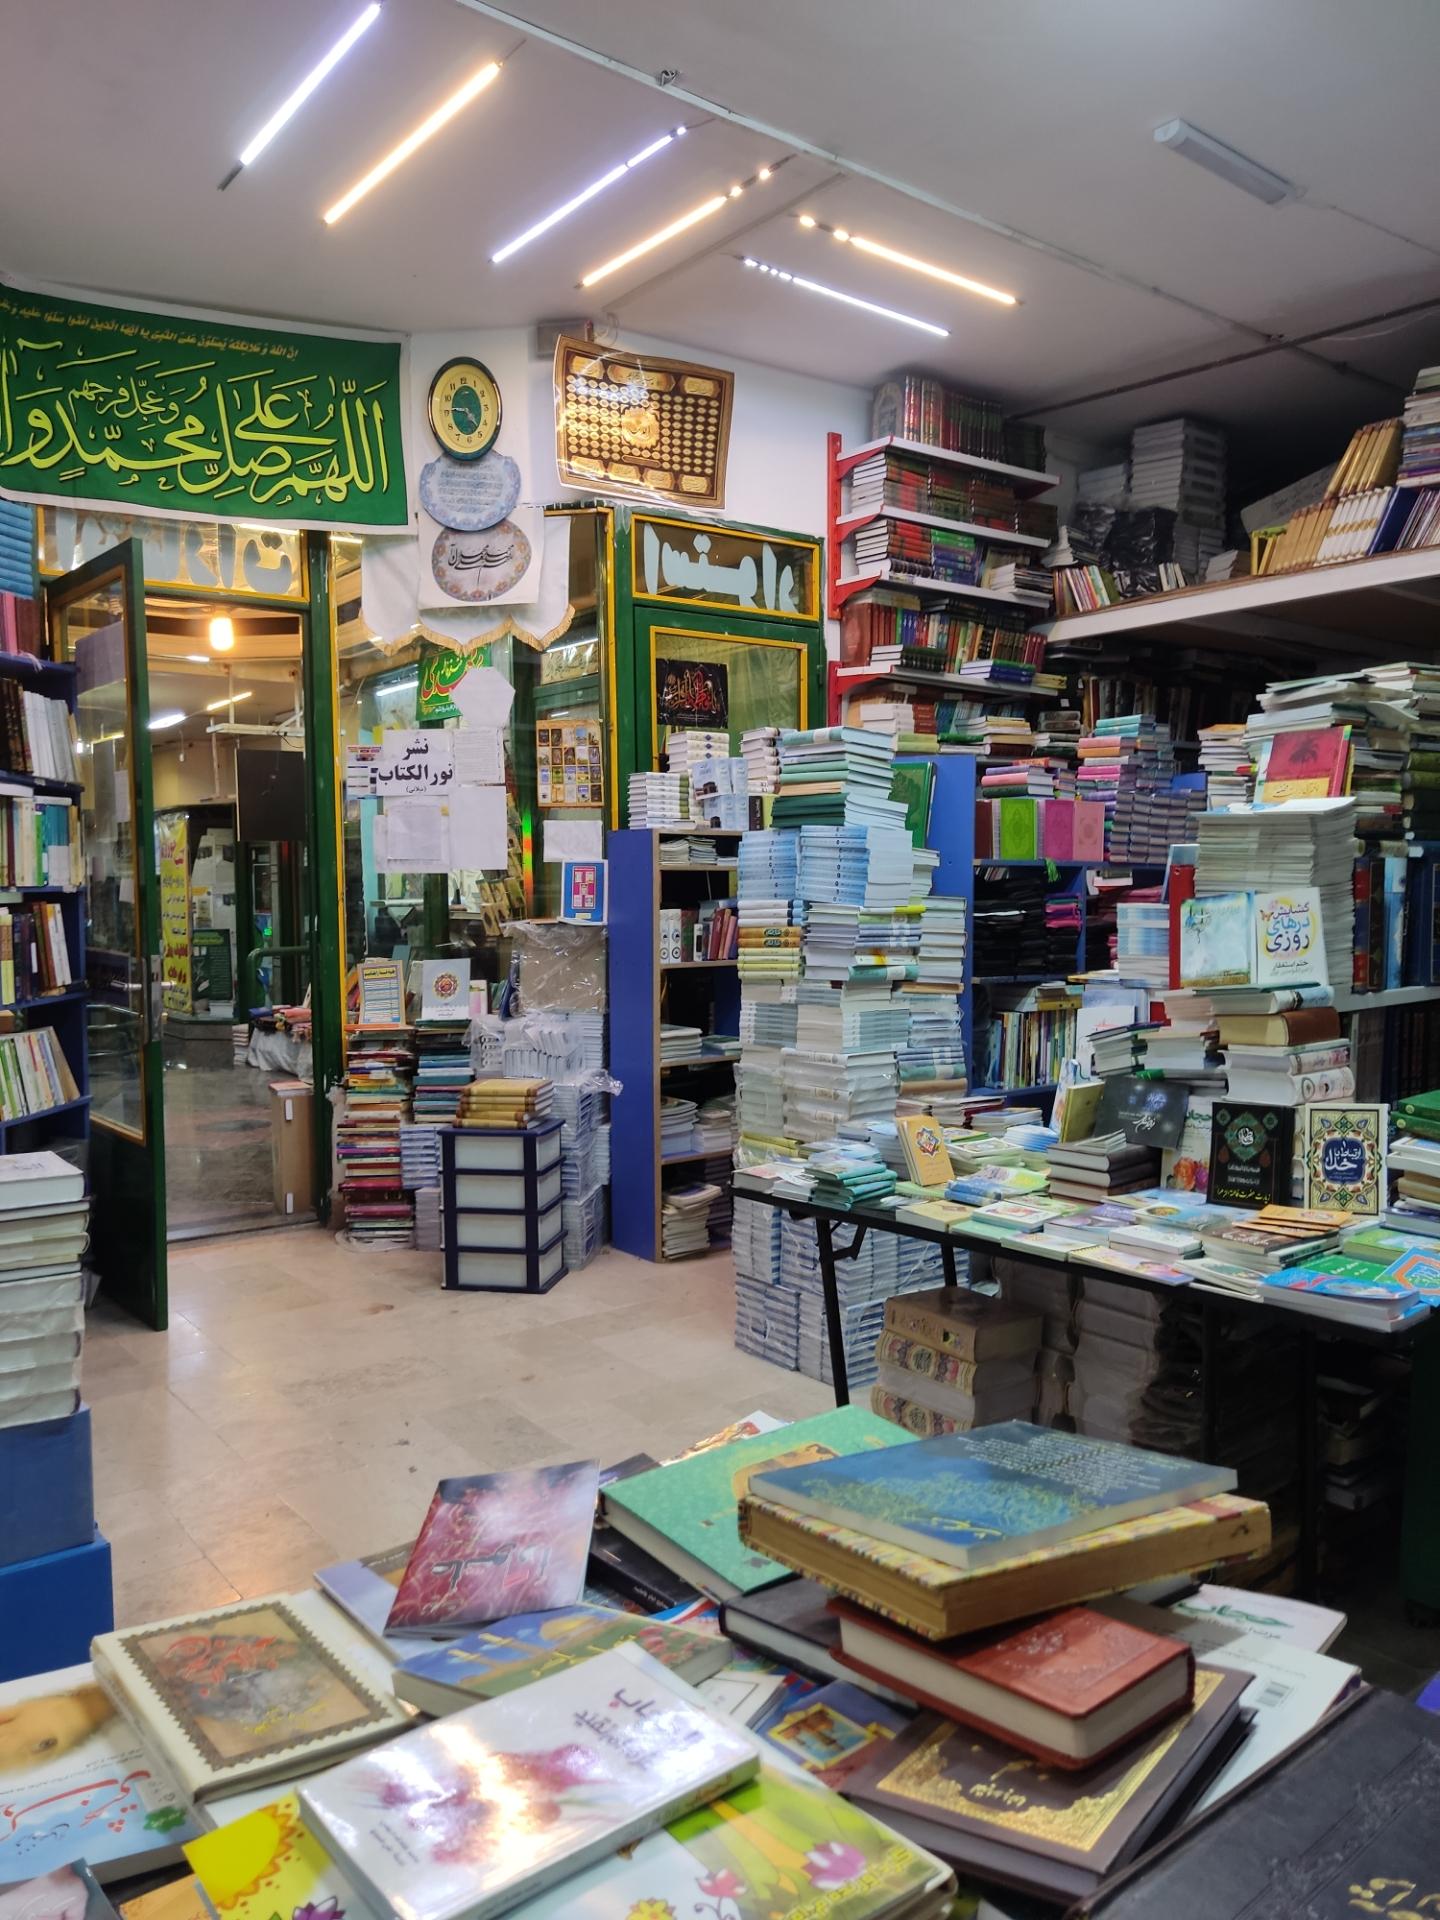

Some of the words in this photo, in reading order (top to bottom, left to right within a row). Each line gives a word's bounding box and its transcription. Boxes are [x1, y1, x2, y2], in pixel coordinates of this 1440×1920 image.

[402, 738, 429, 760] نشر
[1266, 916, 1310, 936] درهای
[1266, 931, 1310, 952] روزی
